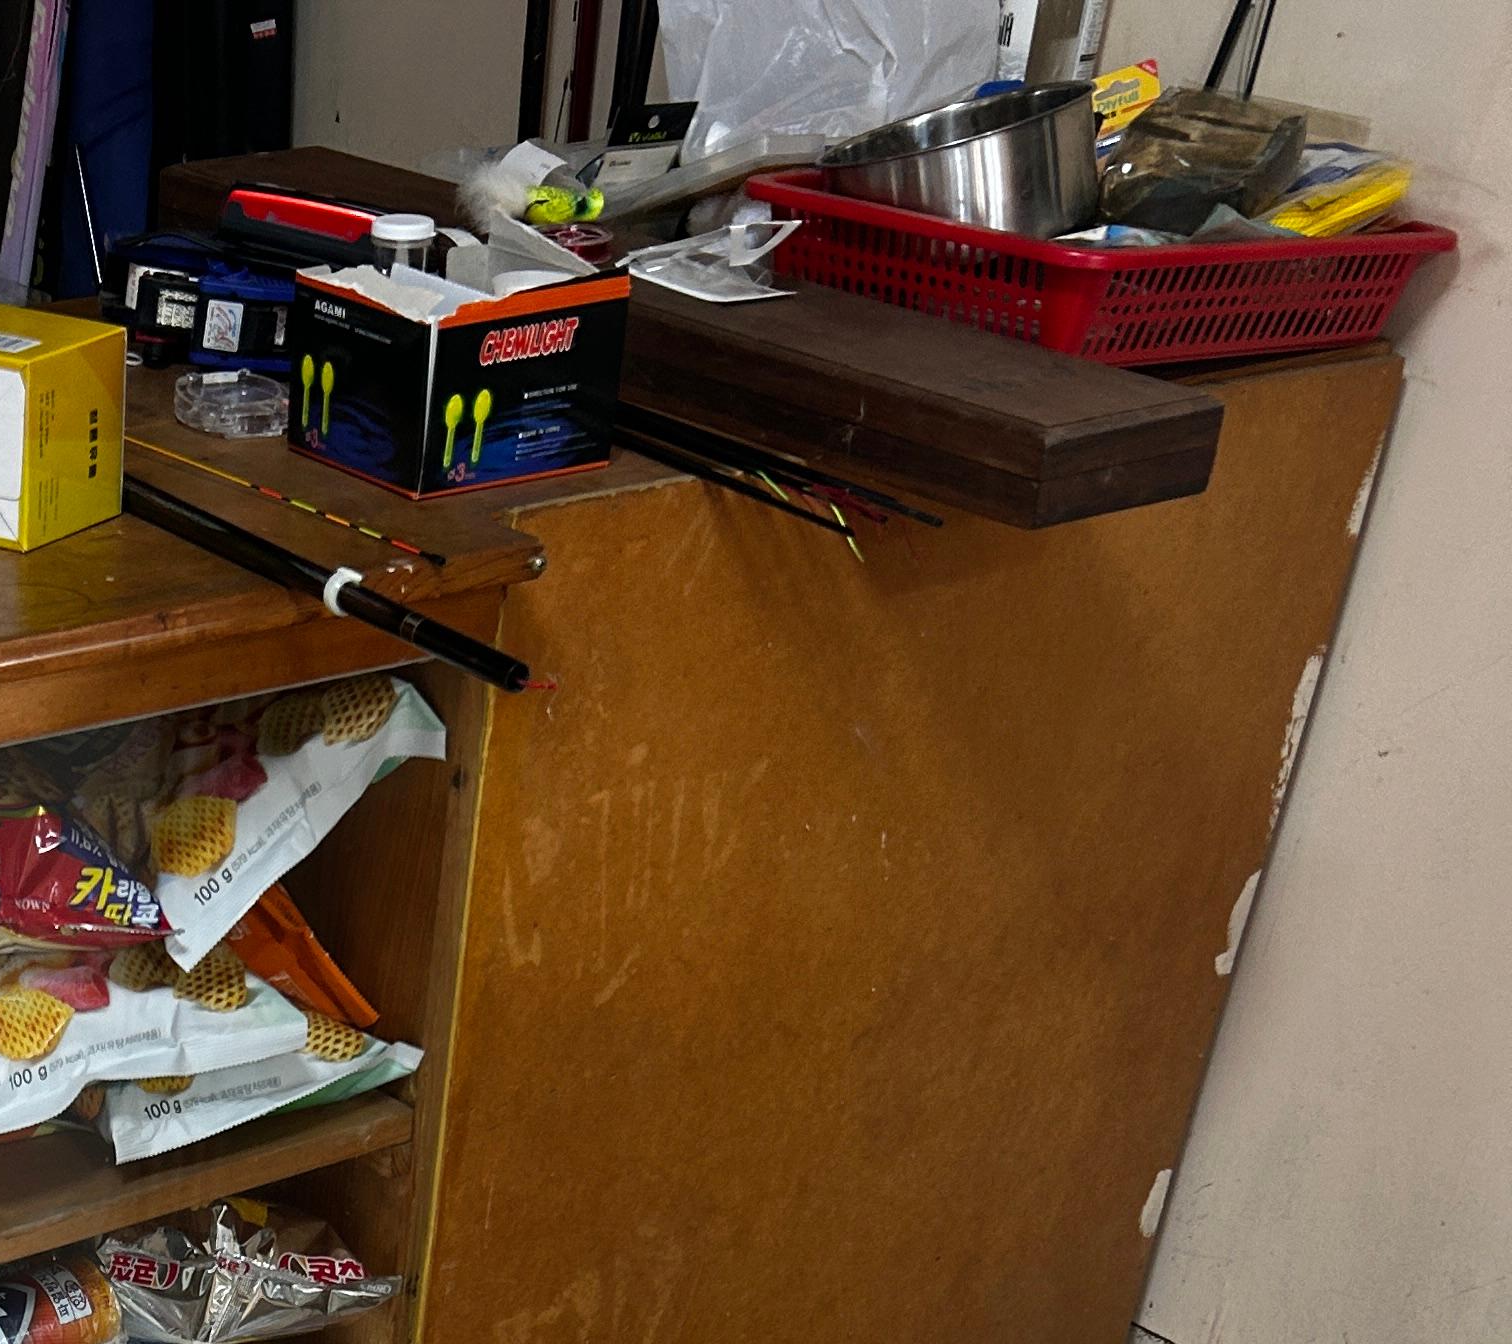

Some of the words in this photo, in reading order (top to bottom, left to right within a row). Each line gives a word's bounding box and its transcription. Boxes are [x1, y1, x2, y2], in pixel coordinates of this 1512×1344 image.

[314, 300, 346, 320] AGAMI
[479, 316, 580, 367] CHEMILIGHT
[193, 874, 221, 907] 100
[8, 1069, 34, 1092] 100
[144, 1099, 171, 1121] 100
